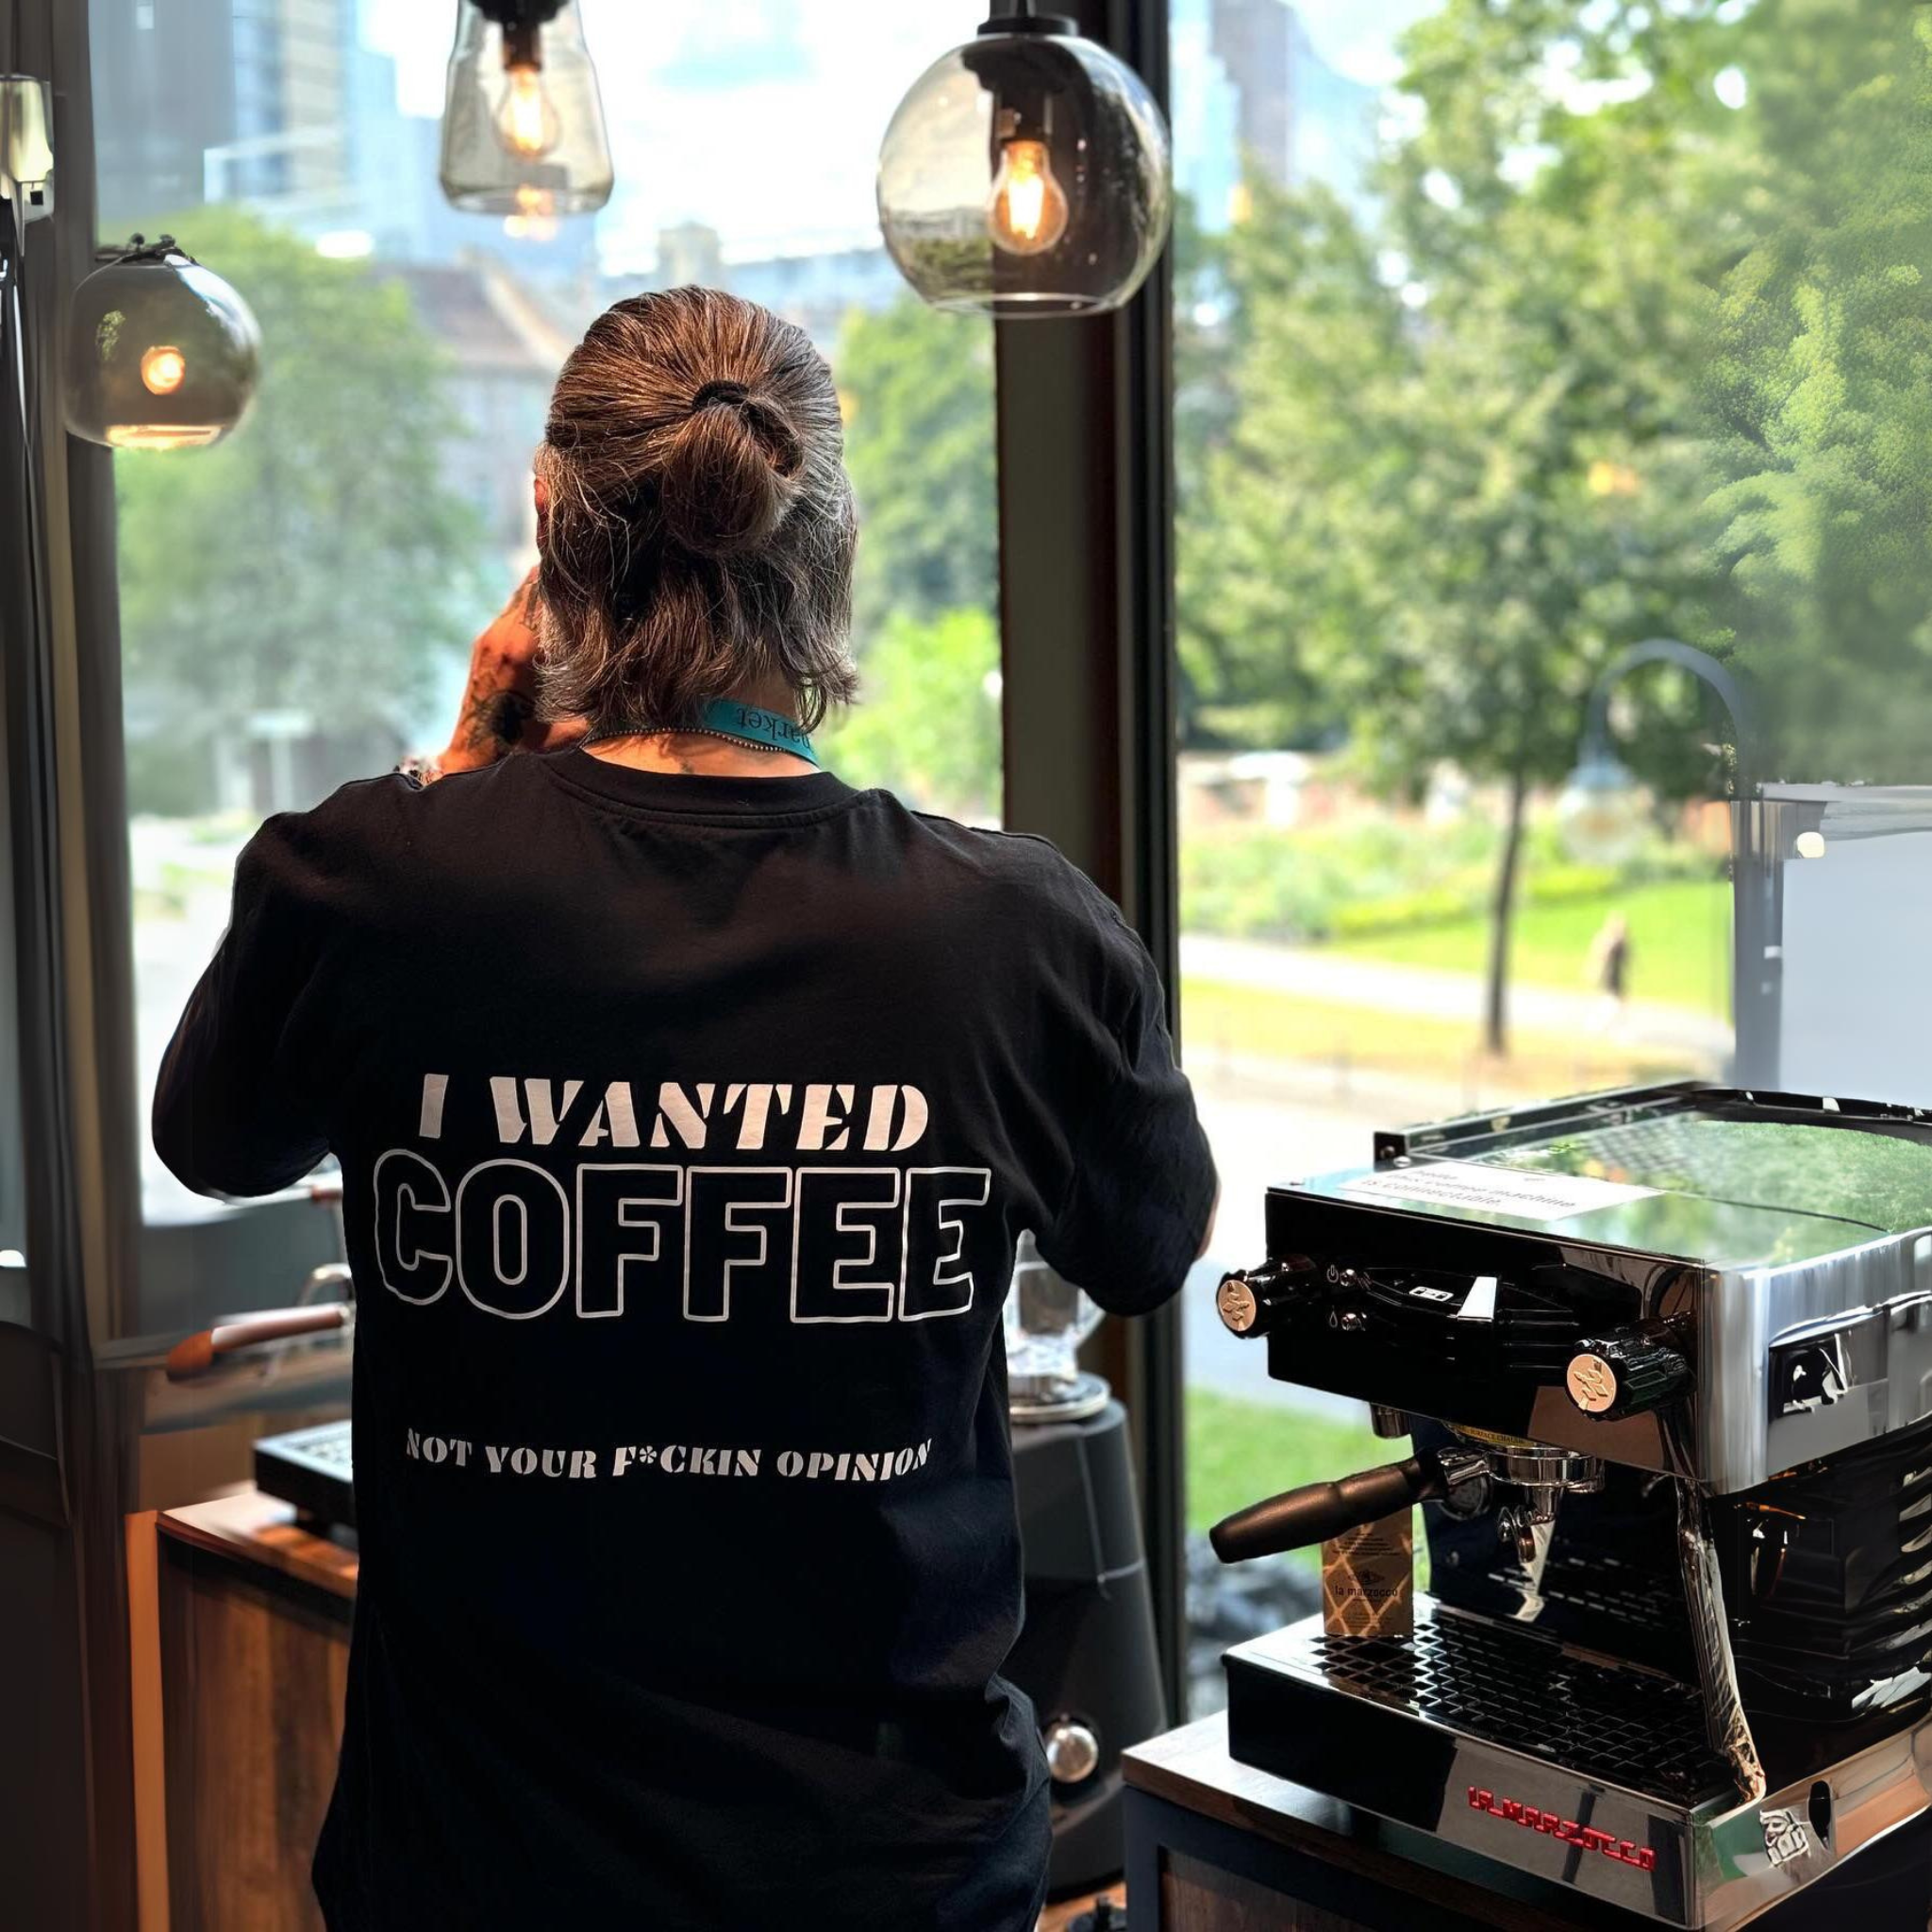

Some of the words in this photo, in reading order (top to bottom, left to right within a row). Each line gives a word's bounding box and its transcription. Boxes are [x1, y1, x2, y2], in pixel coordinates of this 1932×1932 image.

[419, 1073, 450, 1139] I
[489, 1075, 929, 1151] WANTED
[373, 1148, 992, 1324] COFFEE
[407, 1426, 474, 1468] NOT
[485, 1445, 598, 1479] YOUR
[776, 1438, 932, 1483] OPINION
